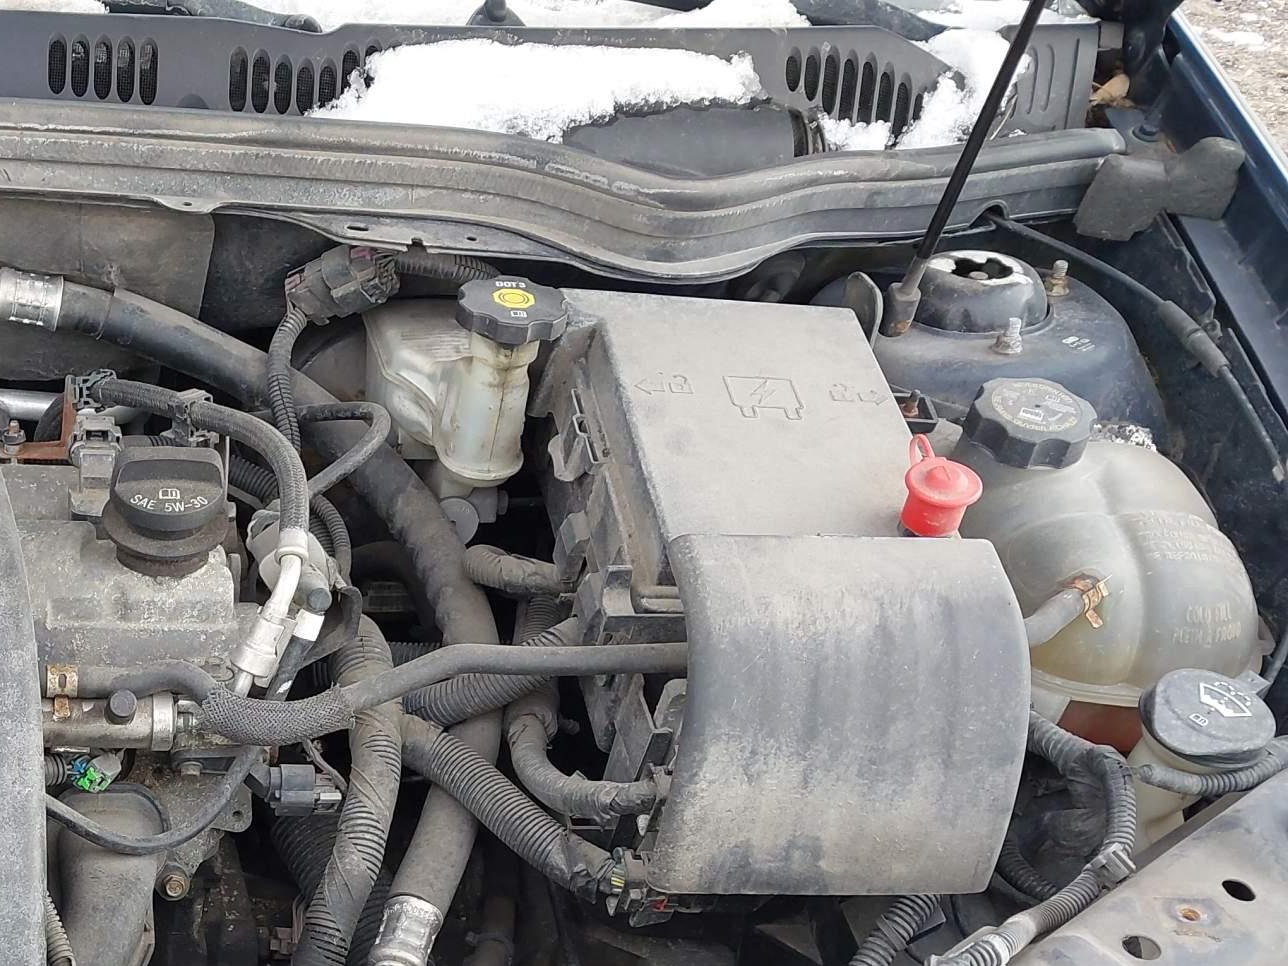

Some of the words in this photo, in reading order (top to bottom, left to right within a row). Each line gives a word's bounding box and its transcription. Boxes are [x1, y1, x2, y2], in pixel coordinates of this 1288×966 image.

[495, 280, 517, 288] DOT
[129, 494, 155, 510] SAE
[164, 496, 209, 512] 5W-30
